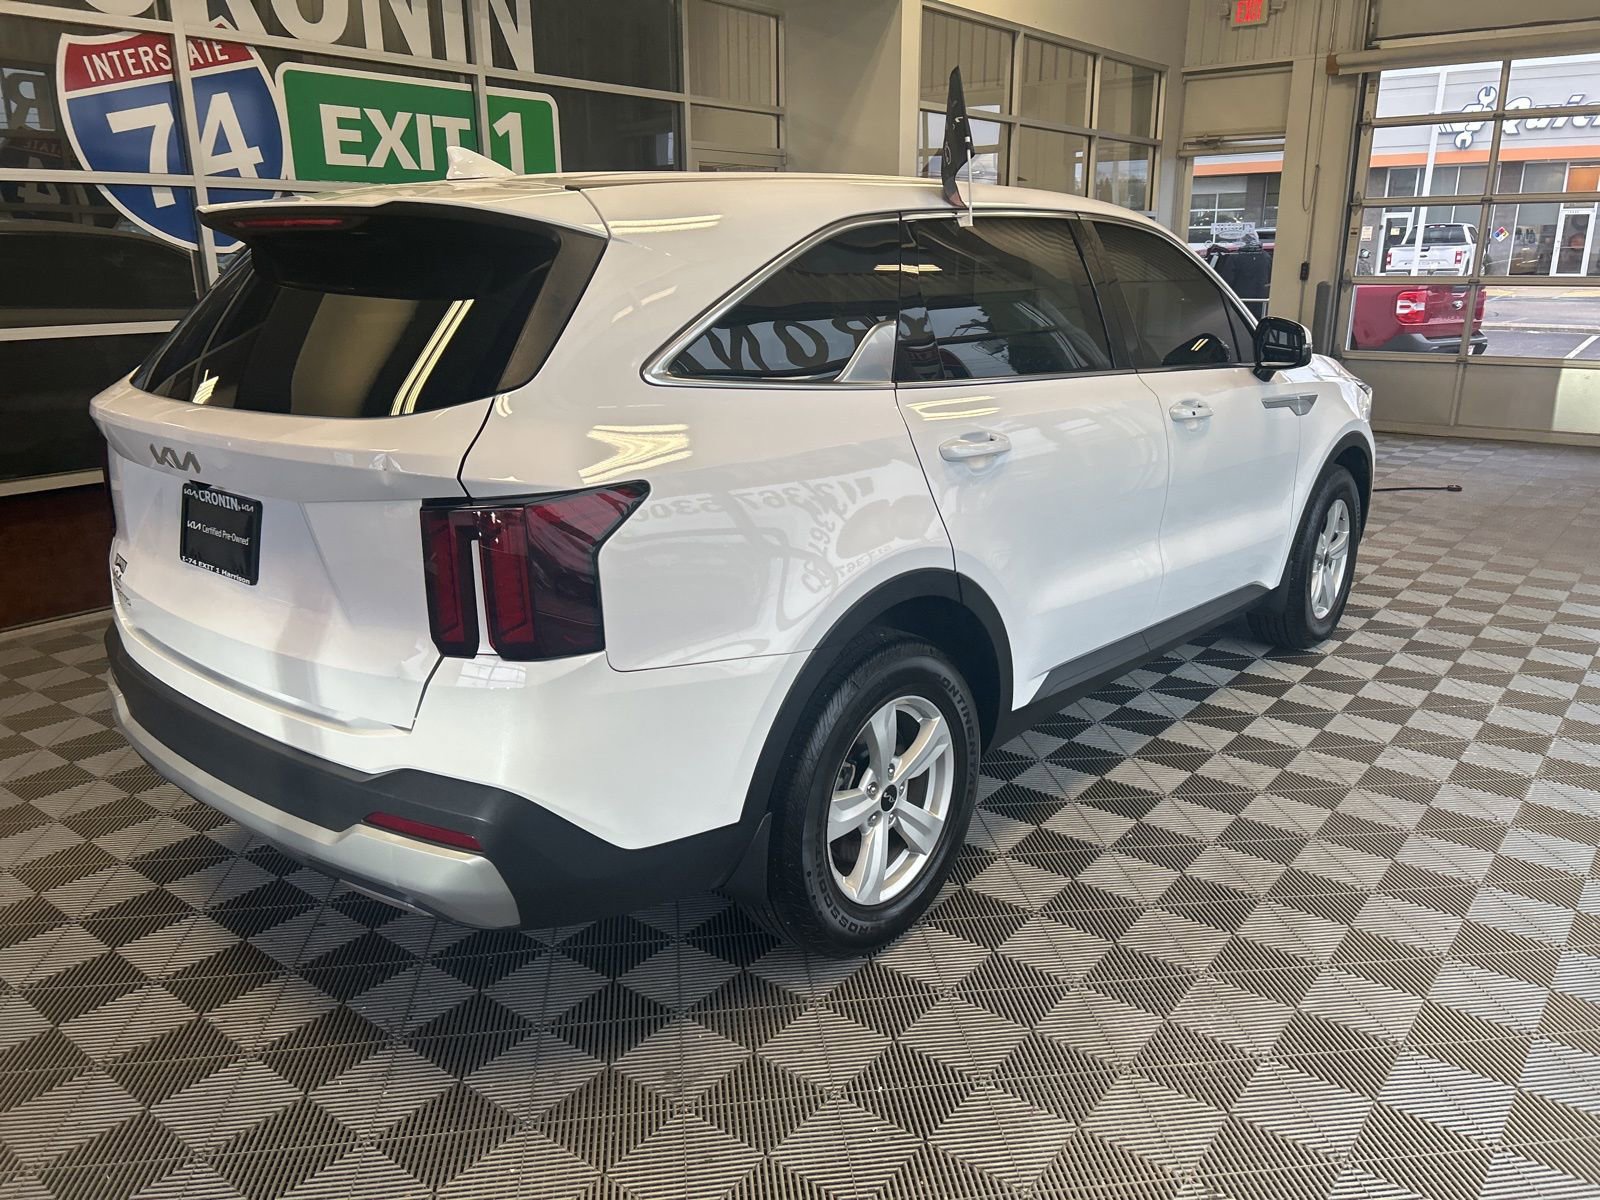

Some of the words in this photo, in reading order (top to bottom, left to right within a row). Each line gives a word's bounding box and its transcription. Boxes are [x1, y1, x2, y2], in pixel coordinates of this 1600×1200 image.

[1234, 0, 1263, 23] EXIT
[84, 0, 535, 74] NIN
[82, 38, 230, 83] INTERSATE
[1498, 93, 1600, 136] Quic
[106, 91, 265, 209] 74
[319, 103, 471, 172] EXIT
[492, 111, 525, 176] 1
[150, 443, 201, 474] KIA
[199, 489, 239, 511] CRONIN
[187, 520, 201, 530] KIA
[202, 524, 222, 538] Certified
[222, 530, 249, 546] Pre-Owned
[198, 561, 215, 571] EXIT
[221, 569, 251, 584] Harrison
